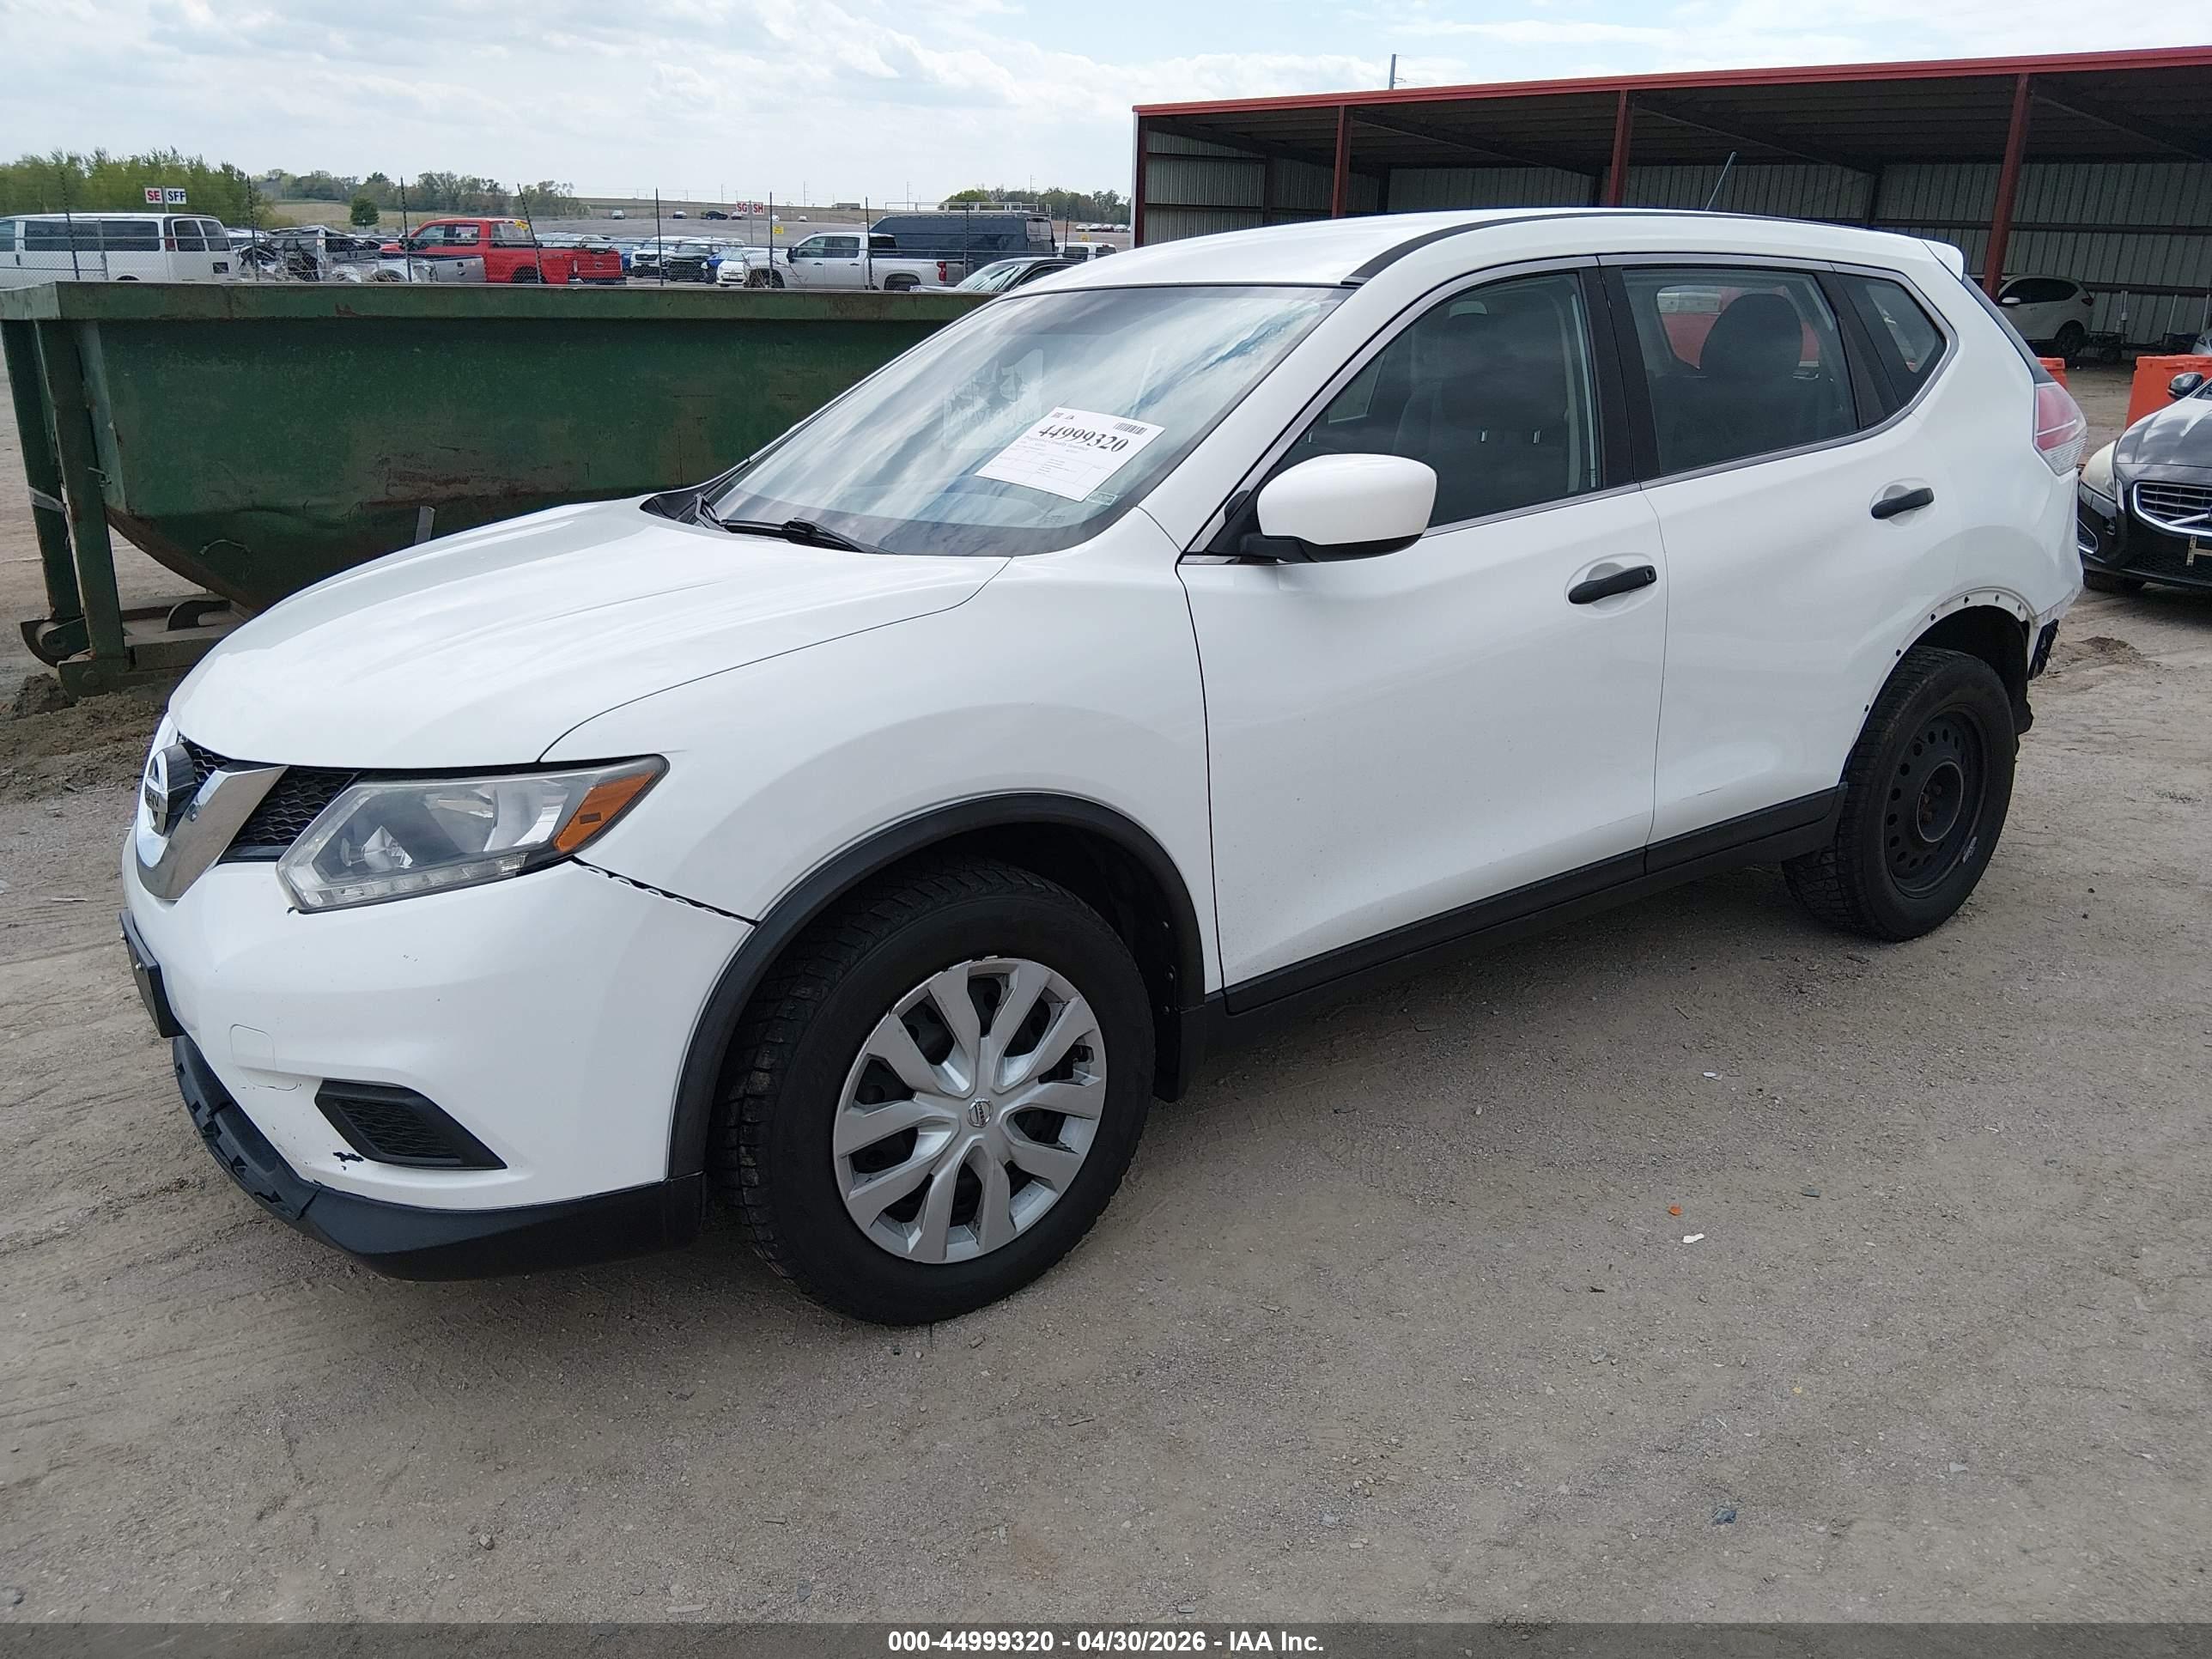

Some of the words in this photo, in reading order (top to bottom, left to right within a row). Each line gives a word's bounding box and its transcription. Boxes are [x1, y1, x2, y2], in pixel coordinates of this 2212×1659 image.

[147, 190, 161, 201] SE
[167, 191, 185, 202] SFF
[737, 203, 747, 213] SG
[753, 204, 763, 214] SH
[1038, 424, 1129, 453] 44999320
